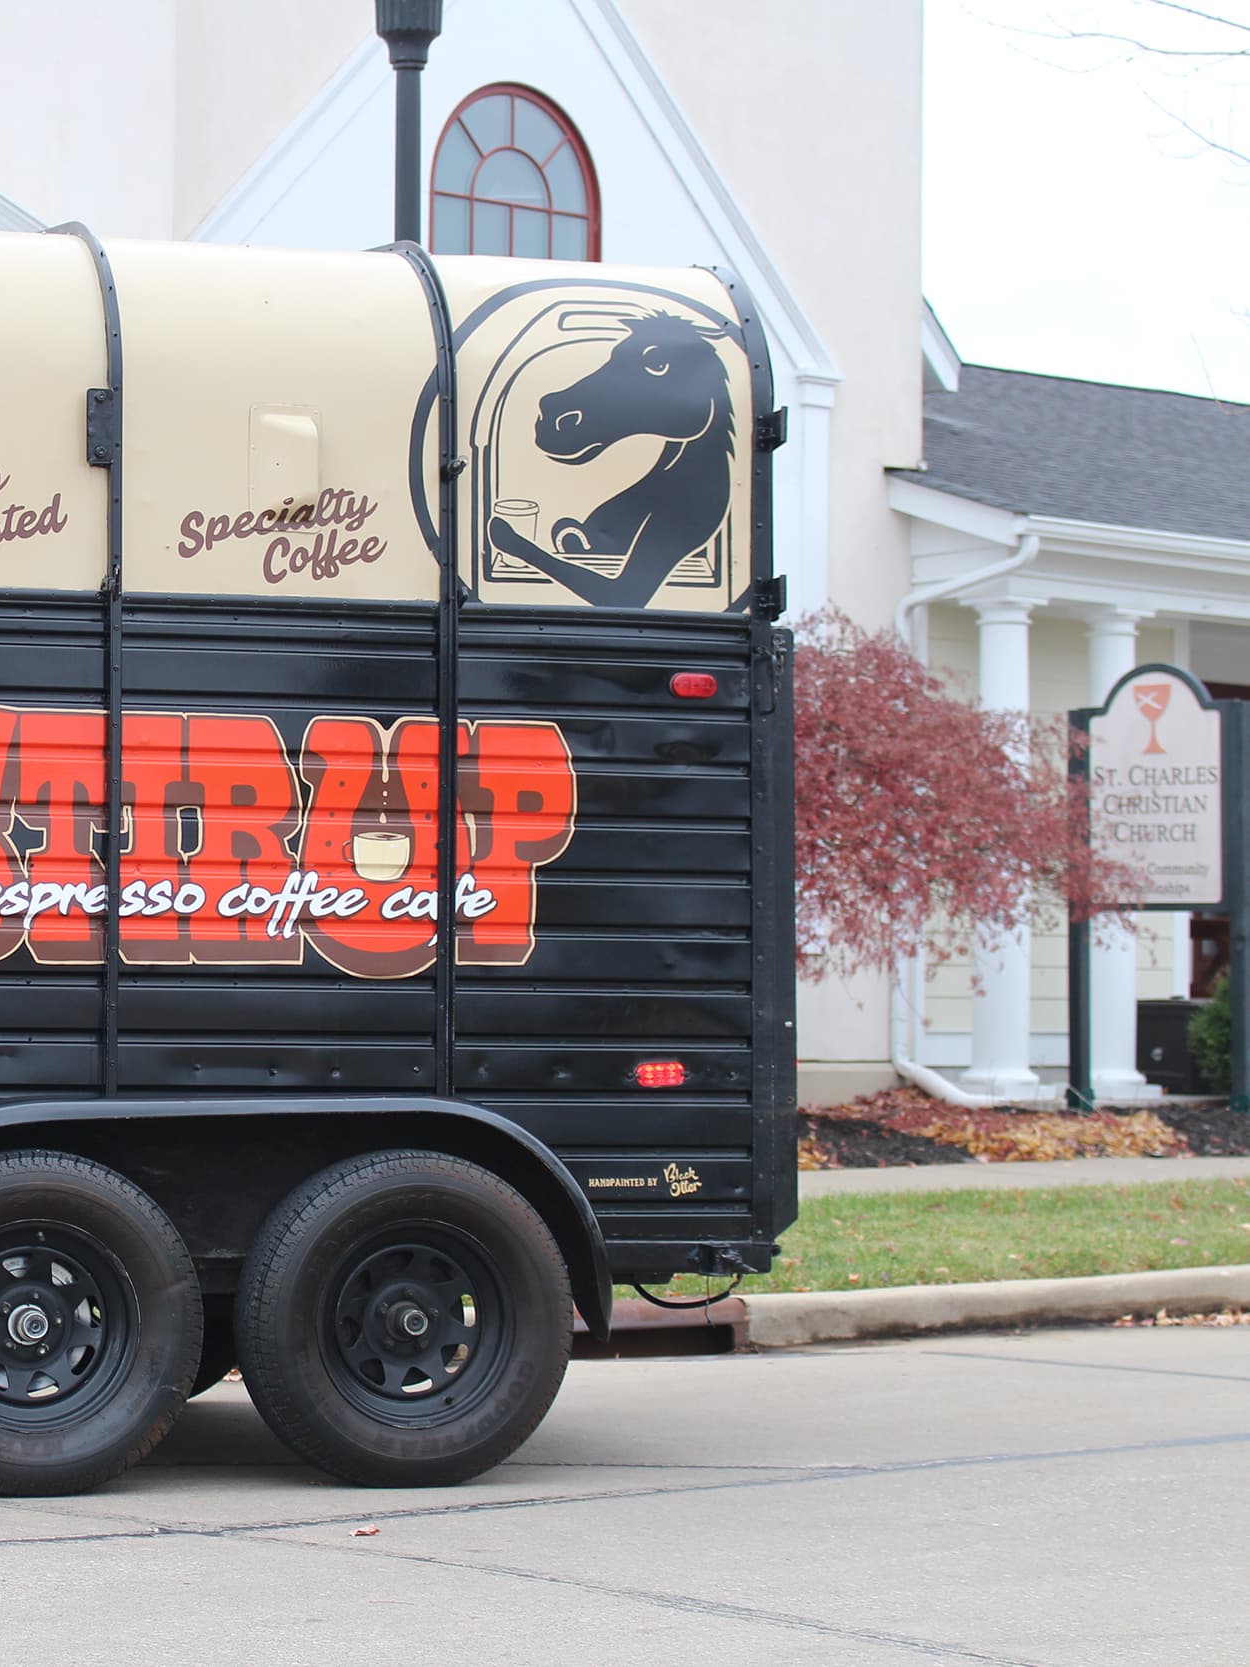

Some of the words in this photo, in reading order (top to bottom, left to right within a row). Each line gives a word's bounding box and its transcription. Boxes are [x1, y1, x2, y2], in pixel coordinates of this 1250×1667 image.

[178, 488, 379, 559] Specialty
[262, 534, 389, 585] Coffee
[1128, 765, 1218, 786] CHARLES
[1103, 791, 1207, 816] CHRISTIAN
[1114, 821, 1197, 843] CHURCH
[216, 871, 370, 939] coffee
[588, 1178, 645, 1188] HANDPAINTED
[647, 1178, 658, 1187] BY
